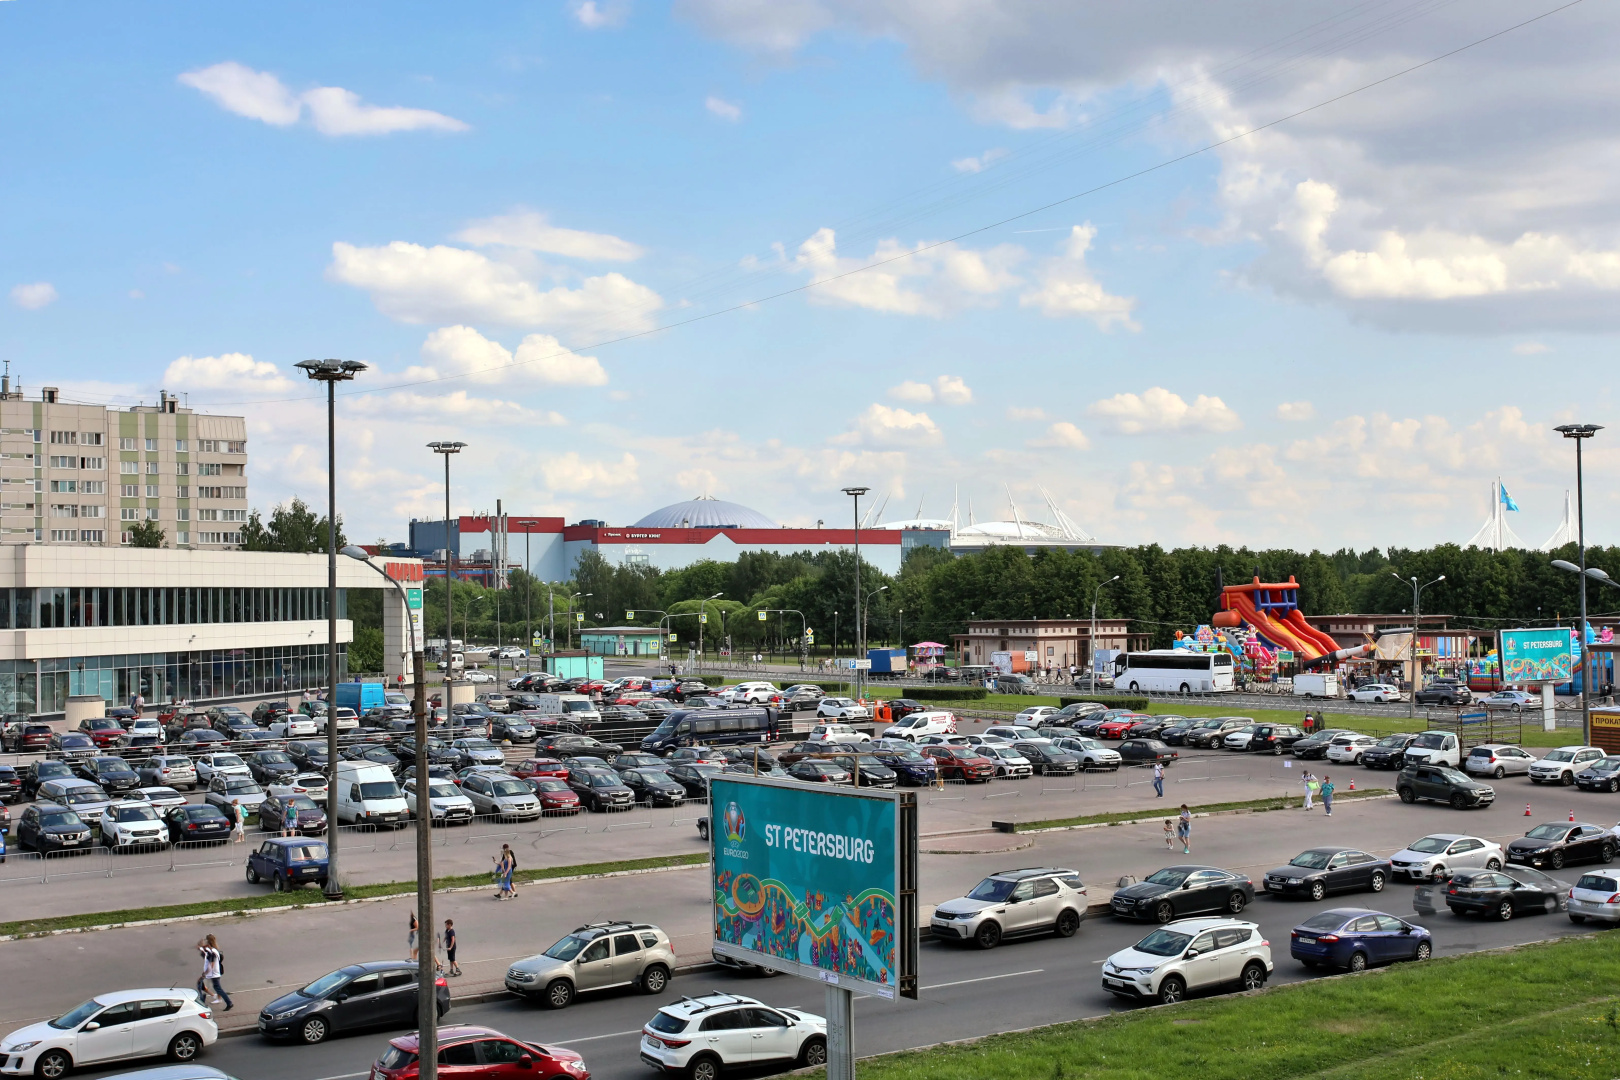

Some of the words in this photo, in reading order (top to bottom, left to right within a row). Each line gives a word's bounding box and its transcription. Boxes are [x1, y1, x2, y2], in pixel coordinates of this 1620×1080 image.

[1523, 641, 1530, 649] ST
[1531, 640, 1563, 649] PETERSBURG
[765, 823, 782, 848] ST
[784, 826, 875, 864] PETERSBURG
[723, 847, 749, 859] EURO2020
